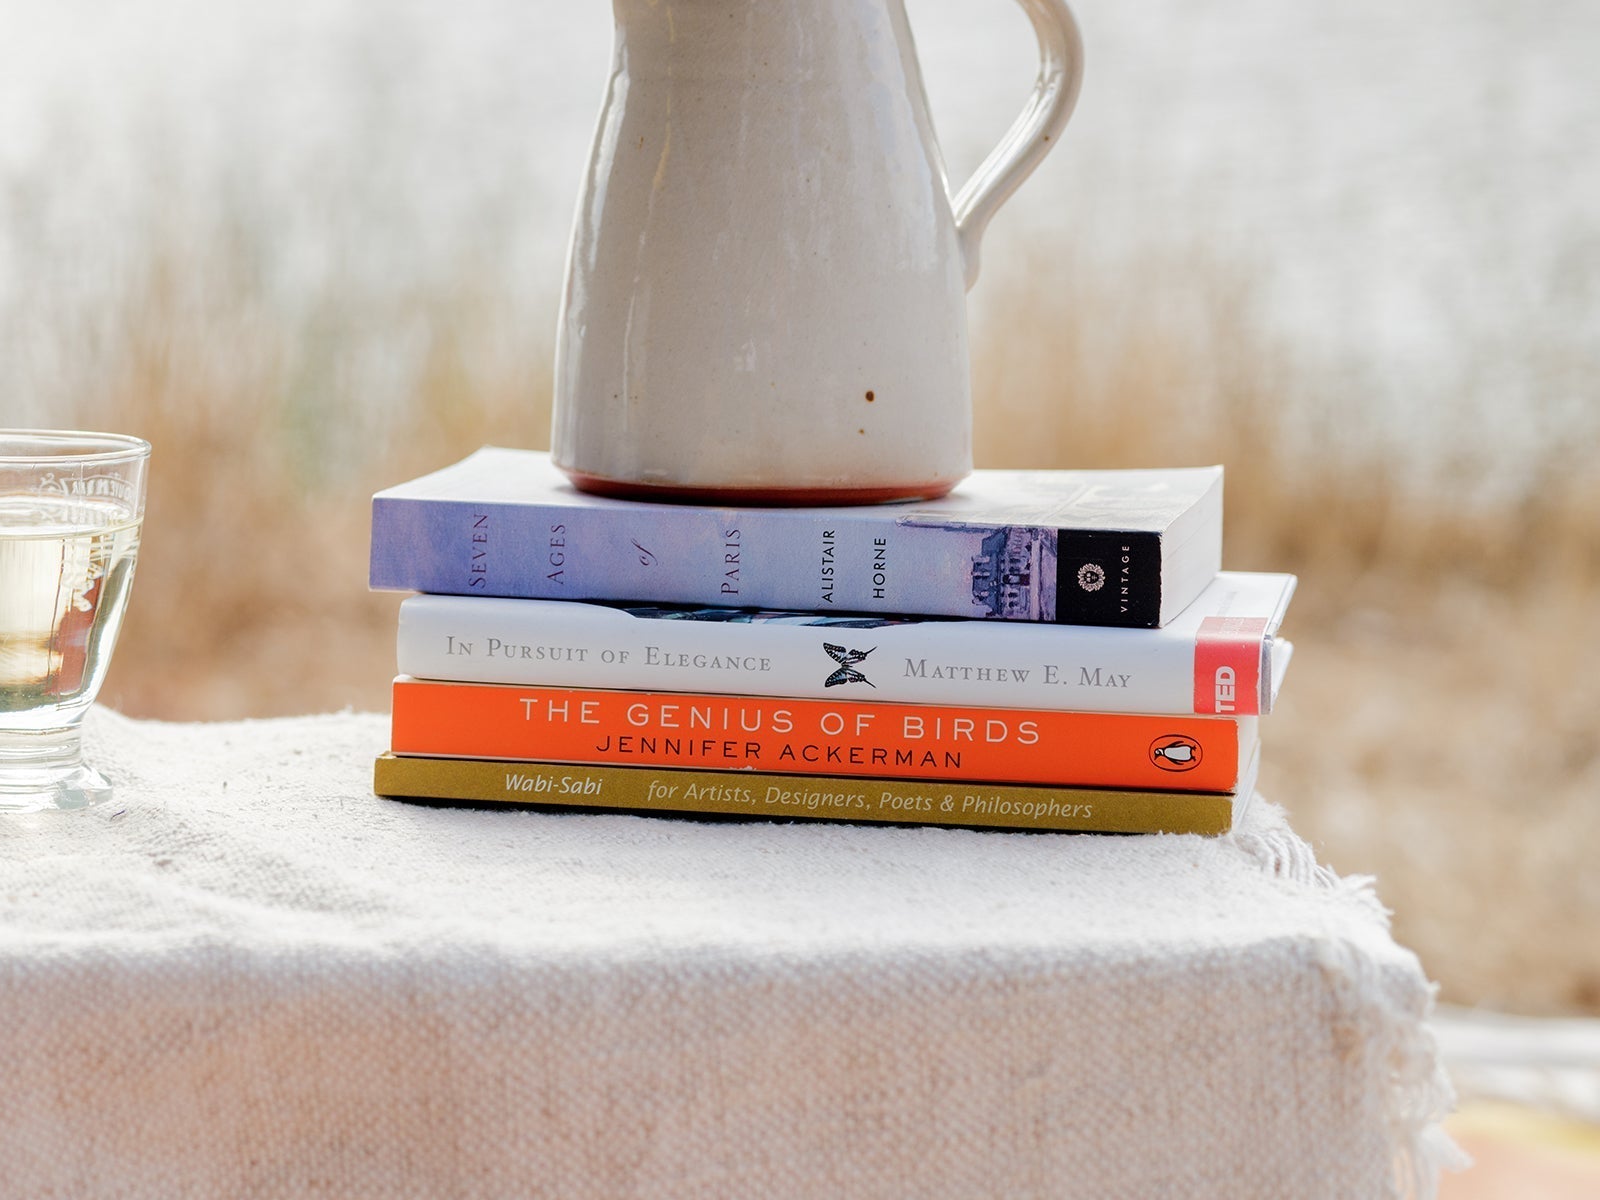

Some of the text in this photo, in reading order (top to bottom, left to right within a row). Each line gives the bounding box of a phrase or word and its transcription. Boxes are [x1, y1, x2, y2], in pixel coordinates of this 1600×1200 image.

[469, 513, 488, 588] SEVEN
[546, 523, 566, 585] AGES
[631, 538, 659, 567] of
[720, 528, 741, 595] PARIS
[821, 529, 835, 603] ALISTAIR
[873, 537, 887, 599] HORNE
[1120, 545, 1130, 613] VINTAGE
[601, 650, 630, 665] OF
[1043, 665, 1067, 685] E.
[1215, 666, 1236, 713] TED
[520, 698, 1040, 745] THE GENIUS OF BIRDS
[596, 735, 961, 769] JENNIFER ACKERMAN
[505, 773, 602, 796] Wabi-Sabi
[647, 780, 1093, 820] for Artists, Designers, Poets & Philosophers
